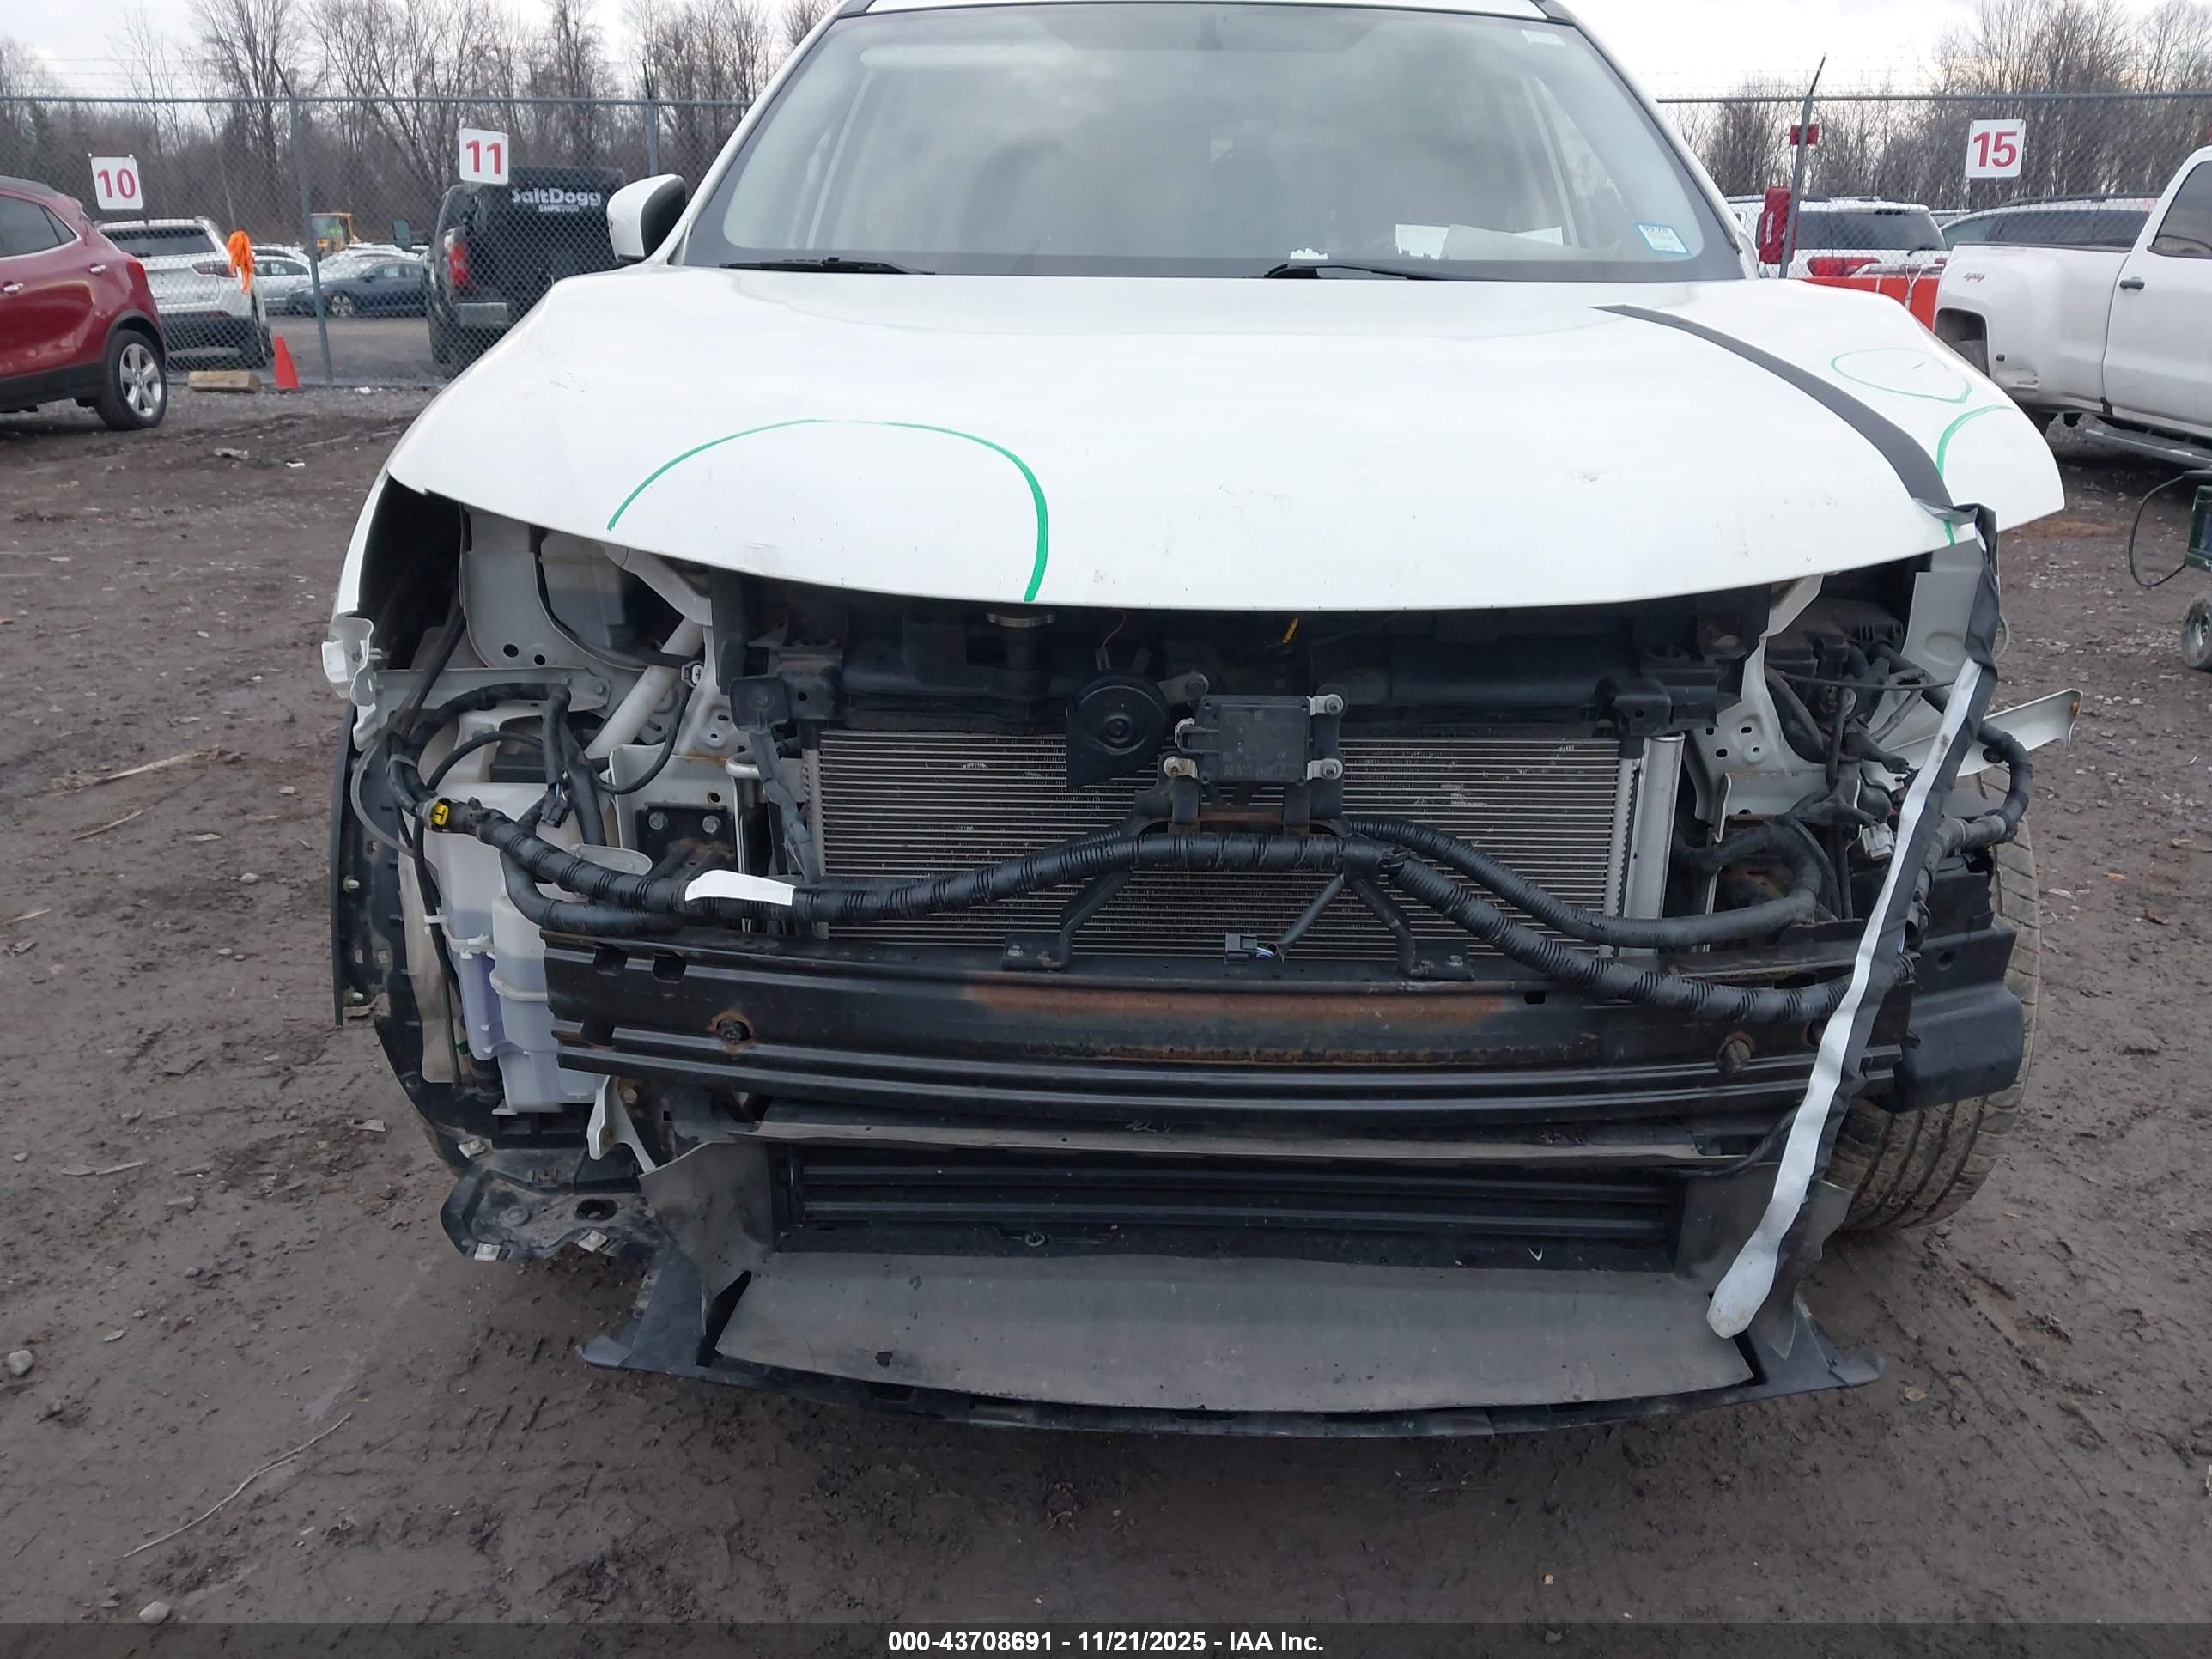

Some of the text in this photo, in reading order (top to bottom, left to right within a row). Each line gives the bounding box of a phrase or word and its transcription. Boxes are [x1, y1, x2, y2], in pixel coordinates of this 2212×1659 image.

[466, 140, 501, 174] 11
[1973, 131, 2018, 167] 15
[97, 168, 136, 199] 10
[511, 187, 601, 206] SaltDogg
